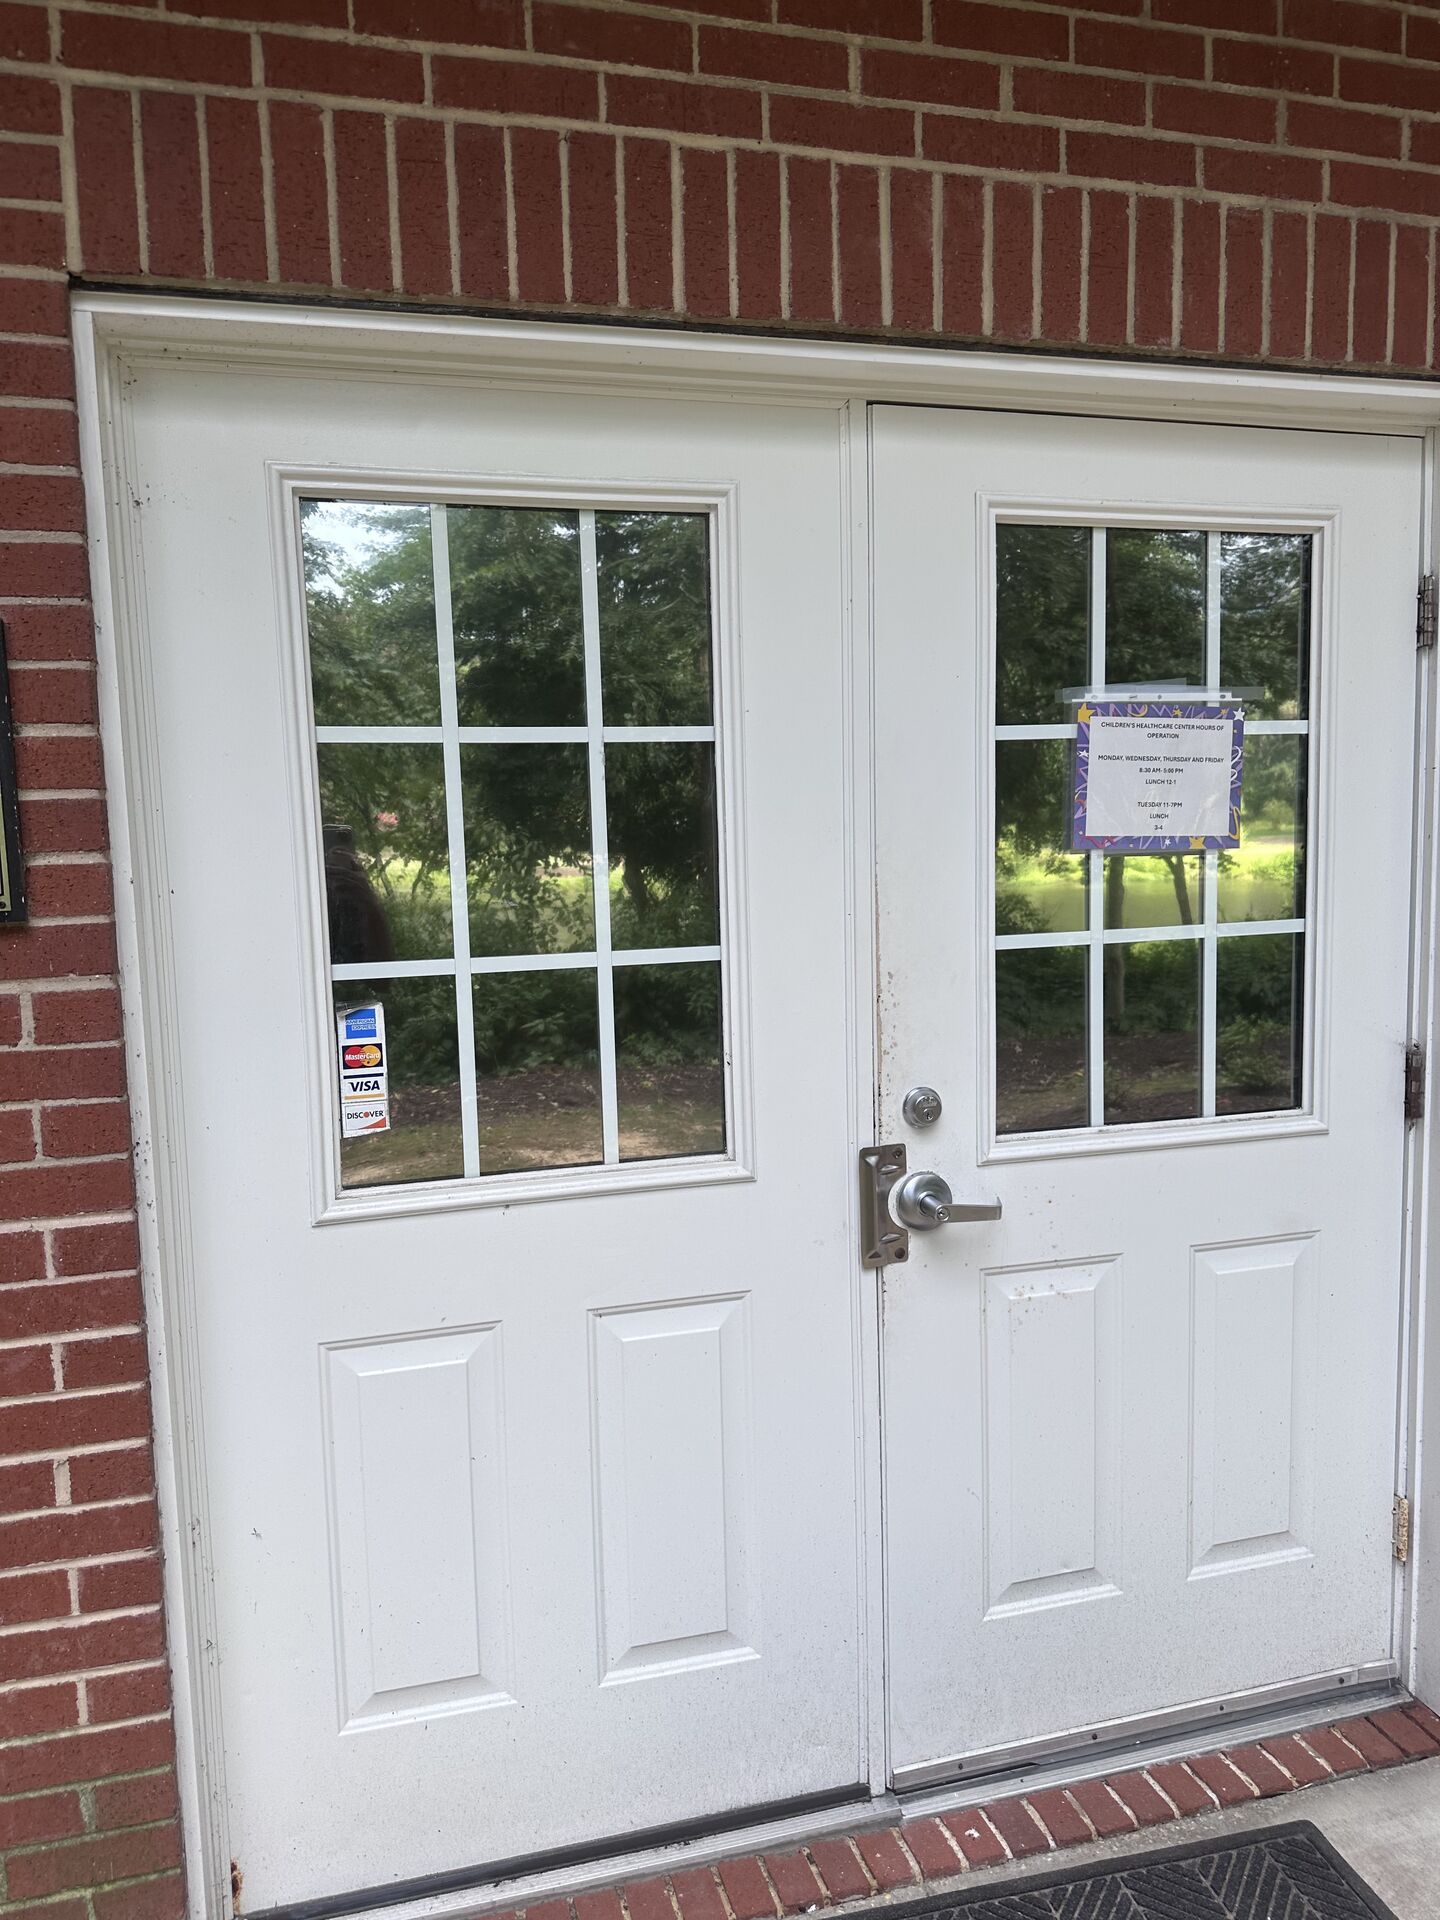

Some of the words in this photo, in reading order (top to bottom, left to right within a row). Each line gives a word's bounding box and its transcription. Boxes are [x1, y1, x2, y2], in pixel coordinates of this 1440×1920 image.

[345, 1052, 380, 1060] MasterCard
[349, 1081, 380, 1092] VISA
[347, 1110, 384, 1119] DISCOVER
